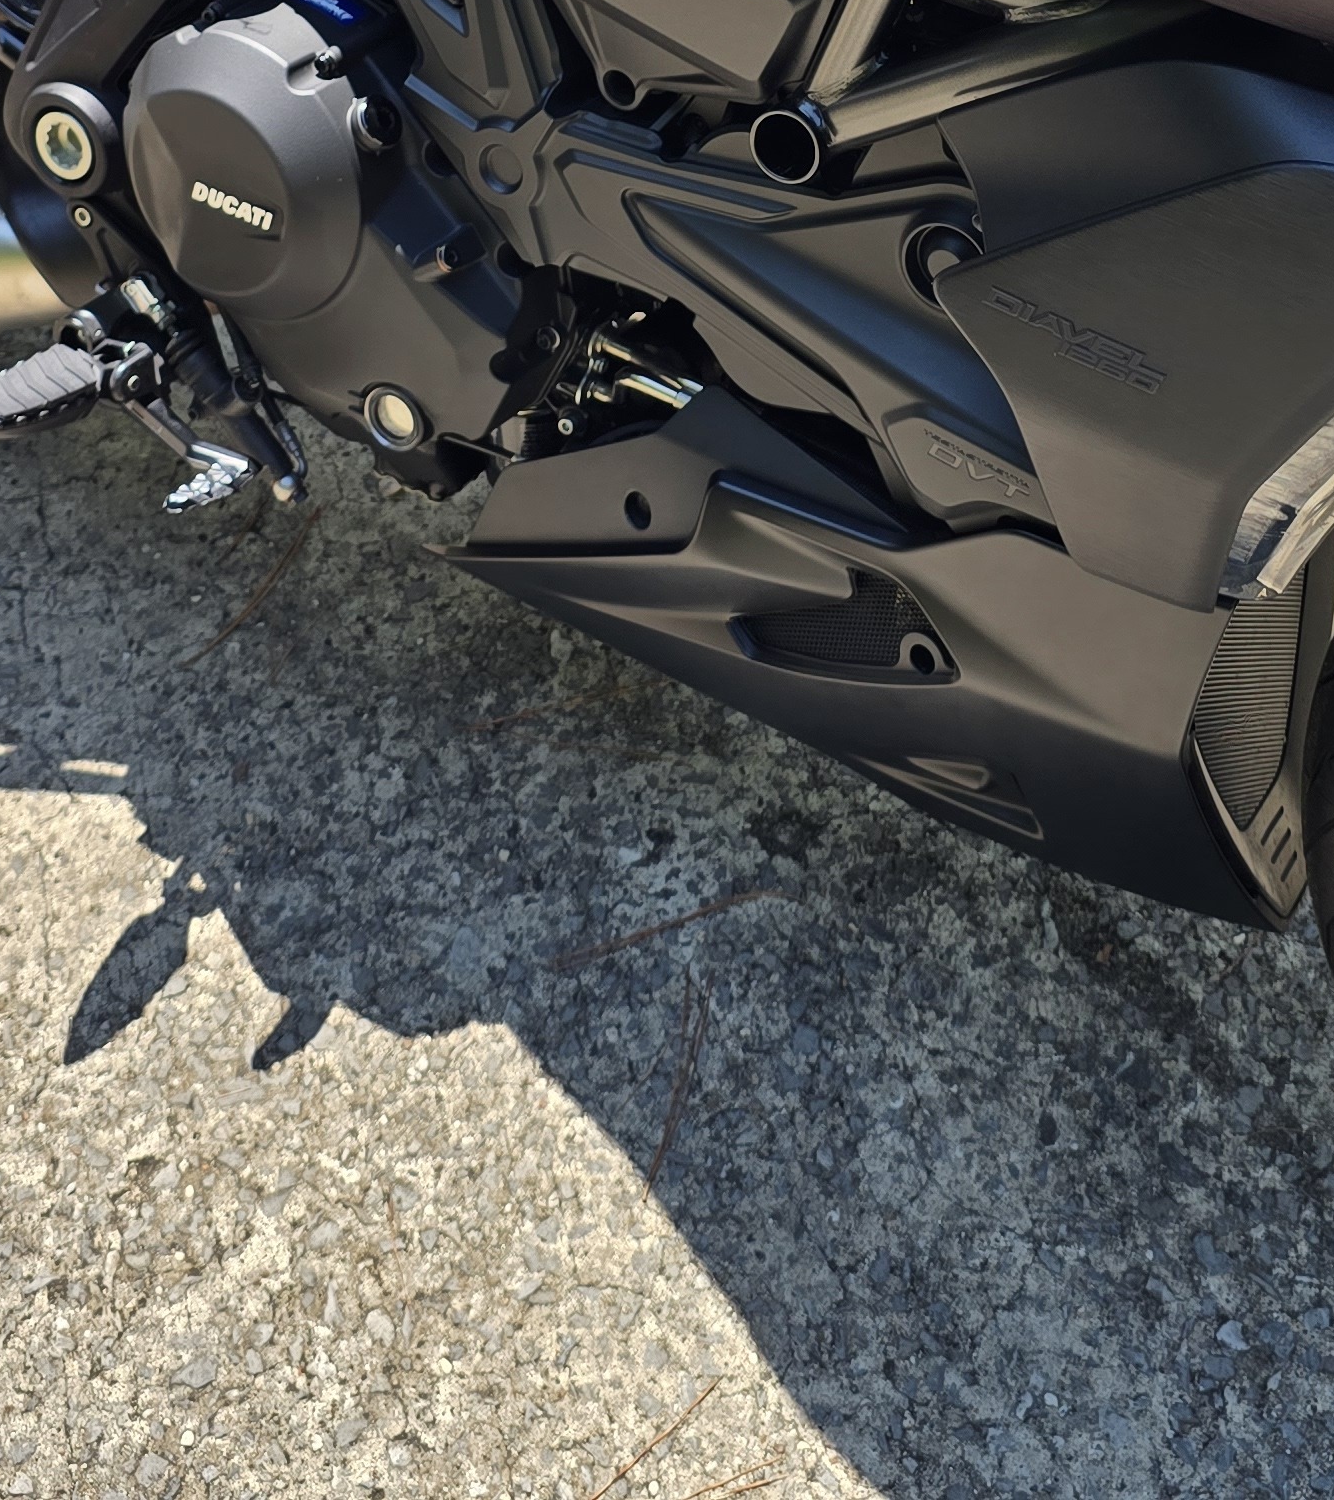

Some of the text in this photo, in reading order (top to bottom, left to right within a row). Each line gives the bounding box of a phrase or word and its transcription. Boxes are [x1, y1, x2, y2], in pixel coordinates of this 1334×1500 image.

[191, 181, 273, 231] DUCATI
[982, 284, 1168, 380] DIAVEL
[1056, 342, 1163, 395] 1260
[927, 443, 1030, 497] DVT
